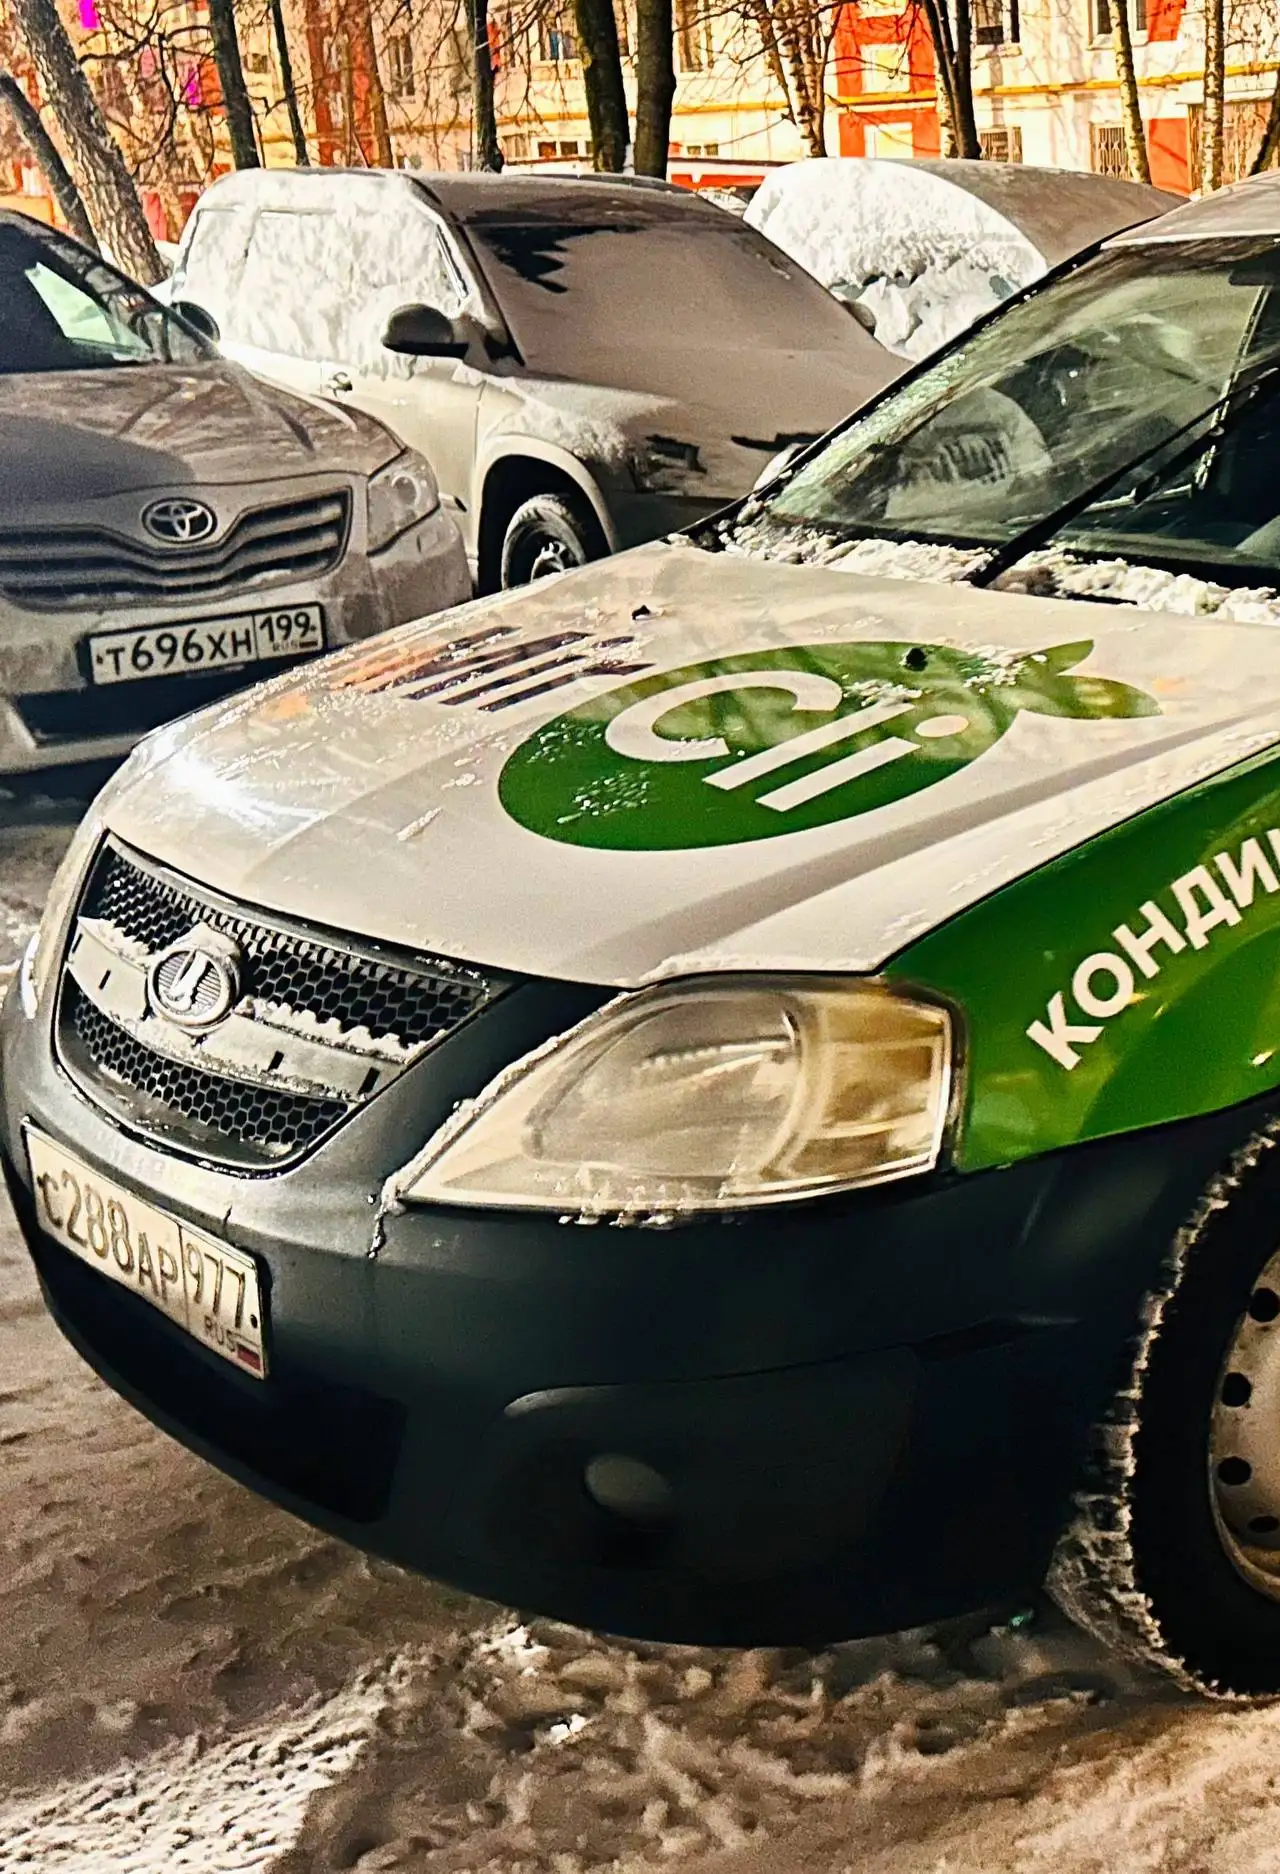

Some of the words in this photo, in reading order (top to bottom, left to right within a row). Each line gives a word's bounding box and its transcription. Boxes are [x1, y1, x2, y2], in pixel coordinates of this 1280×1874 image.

[259, 611, 311, 643] 199
[186, 1241, 246, 1329] 977
[204, 1314, 237, 1353] RUS
